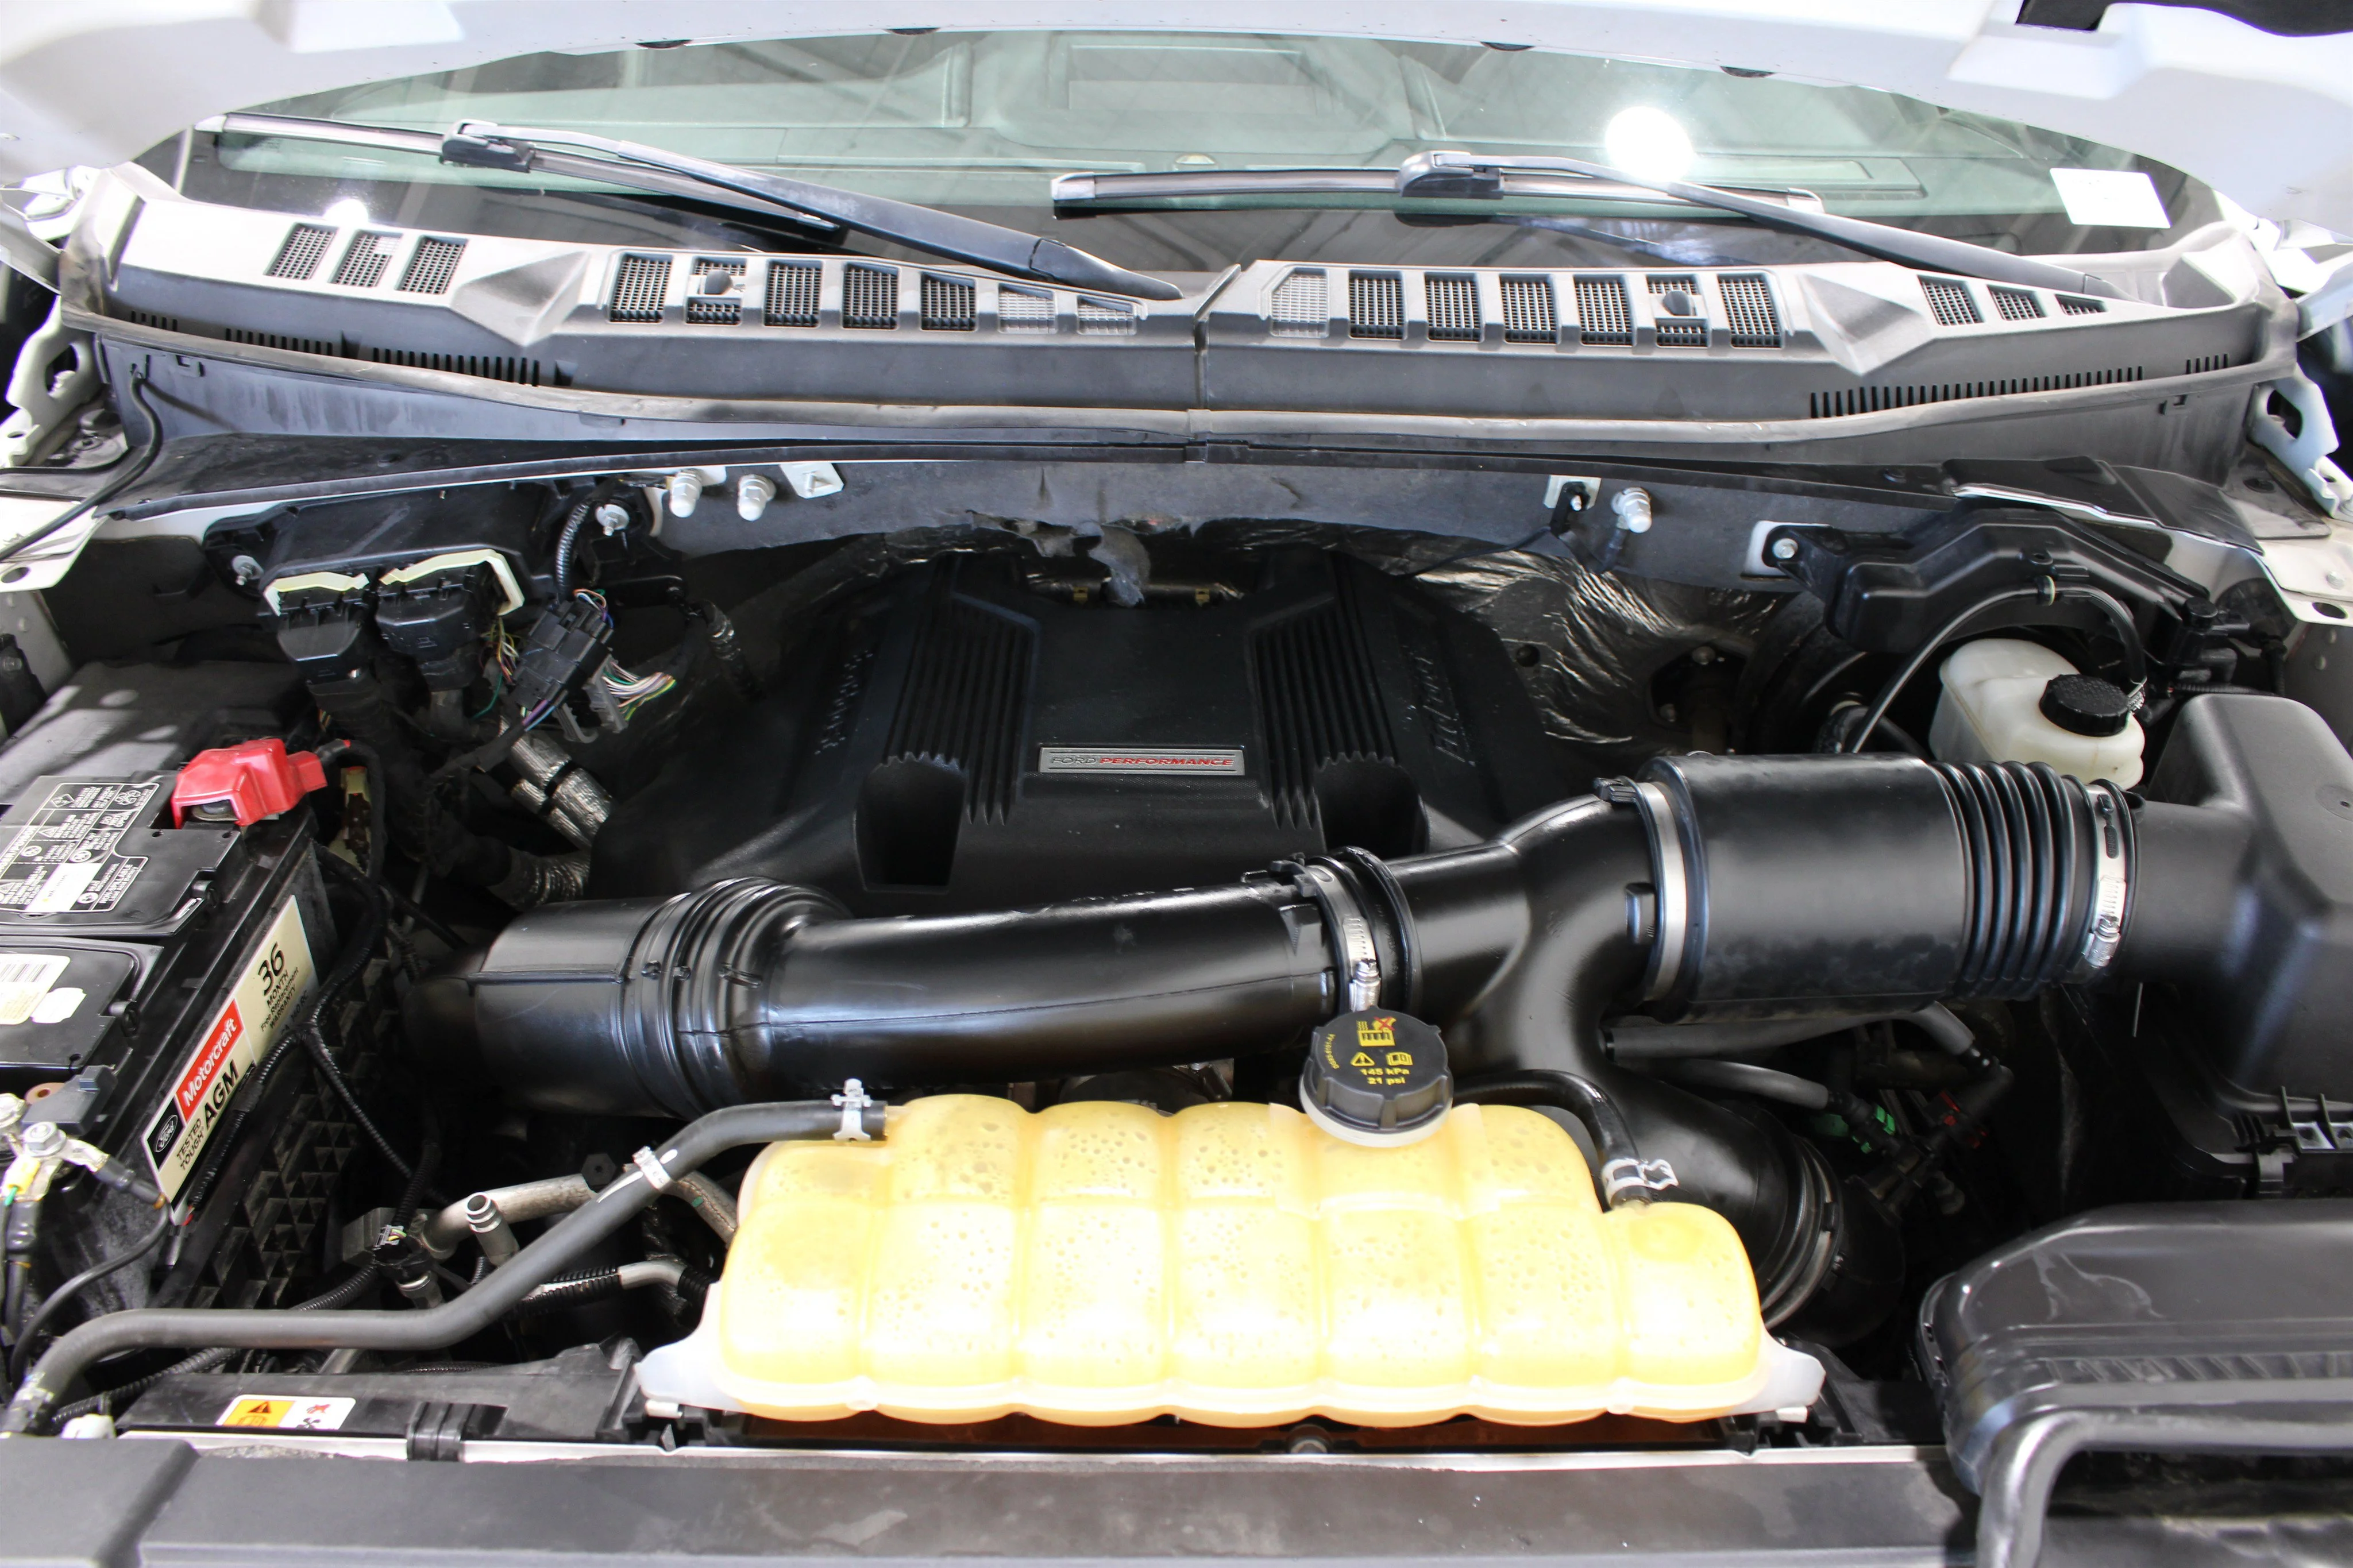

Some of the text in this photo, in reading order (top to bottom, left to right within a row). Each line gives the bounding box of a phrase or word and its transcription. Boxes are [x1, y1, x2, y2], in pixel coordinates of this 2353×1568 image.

[1052, 756, 1234, 767] FORD PERFORMANCE
[97, 864, 133, 903] NON-SPILLABLE
[258, 941, 285, 997] 36
[267, 969, 290, 1008] MONTH
[261, 1014, 272, 1032] Free
[271, 967, 299, 1015] Replacement
[270, 984, 296, 1029] WARRANTY
[183, 1017, 237, 1107] Motorcraft
[1360, 1067, 1410, 1076] 145 kPa
[1367, 1076, 1406, 1086] 21 psi
[203, 1059, 240, 1131] AGM
[176, 1118, 202, 1160] TESTED
